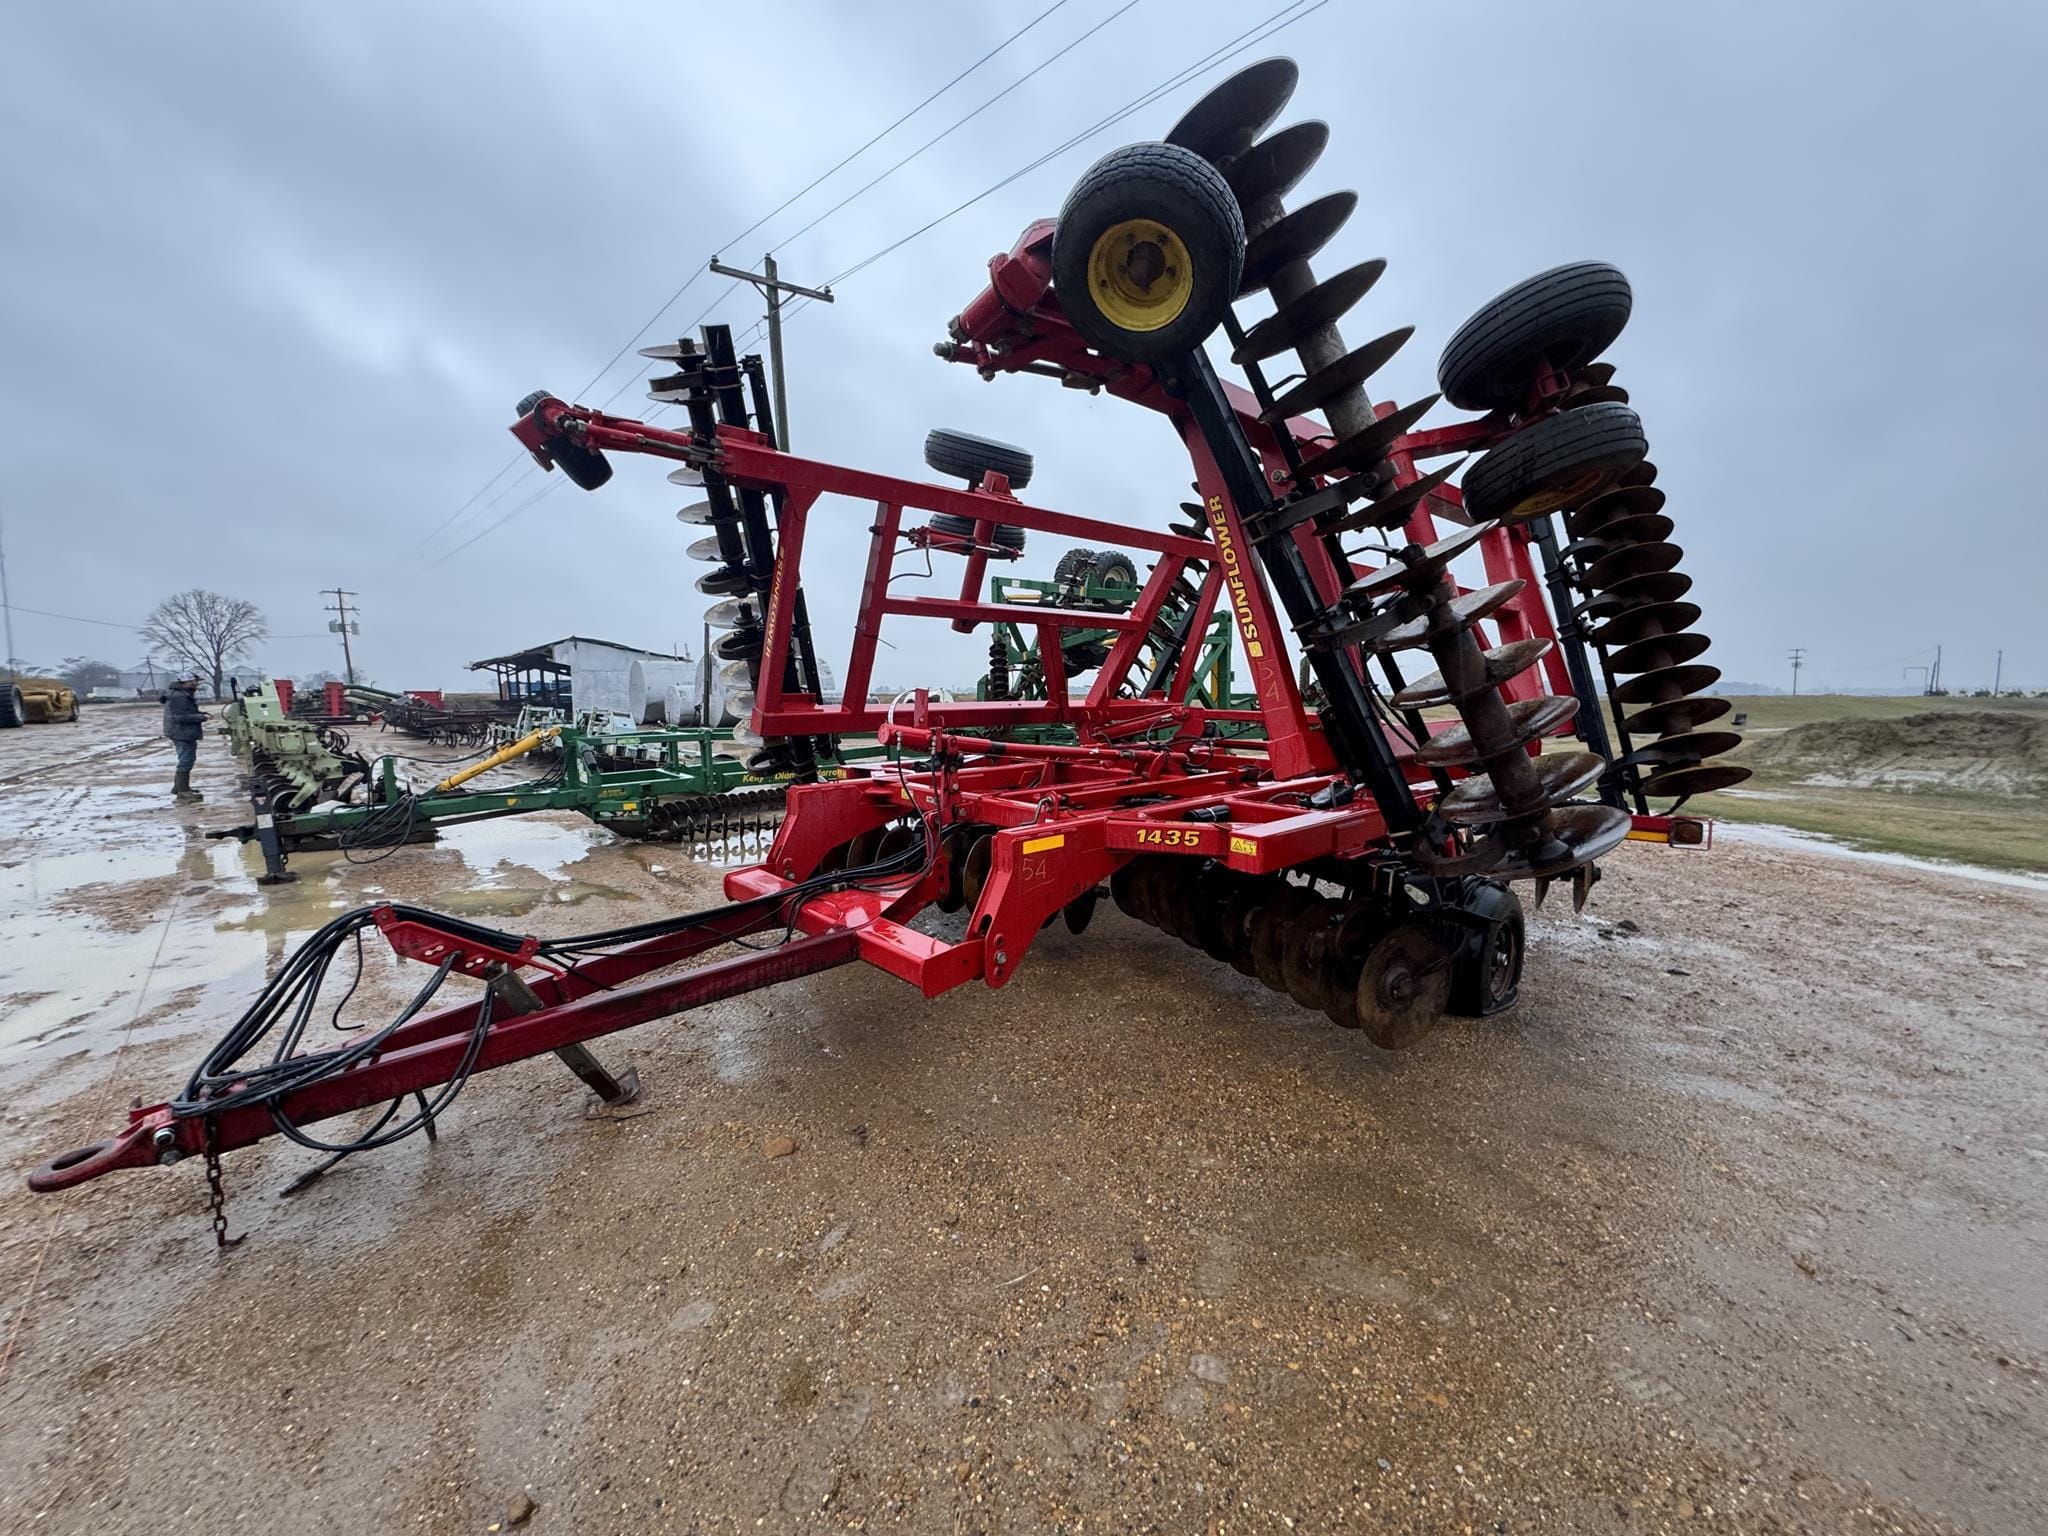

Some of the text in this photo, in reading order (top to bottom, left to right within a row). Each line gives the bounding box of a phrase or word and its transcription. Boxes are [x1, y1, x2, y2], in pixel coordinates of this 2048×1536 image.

[1209, 495, 1258, 639] SUNFLOWER
[765, 560, 783, 658] SUNFLOWER
[1135, 828, 1200, 847] 1435
[1022, 857, 1047, 880] 54
